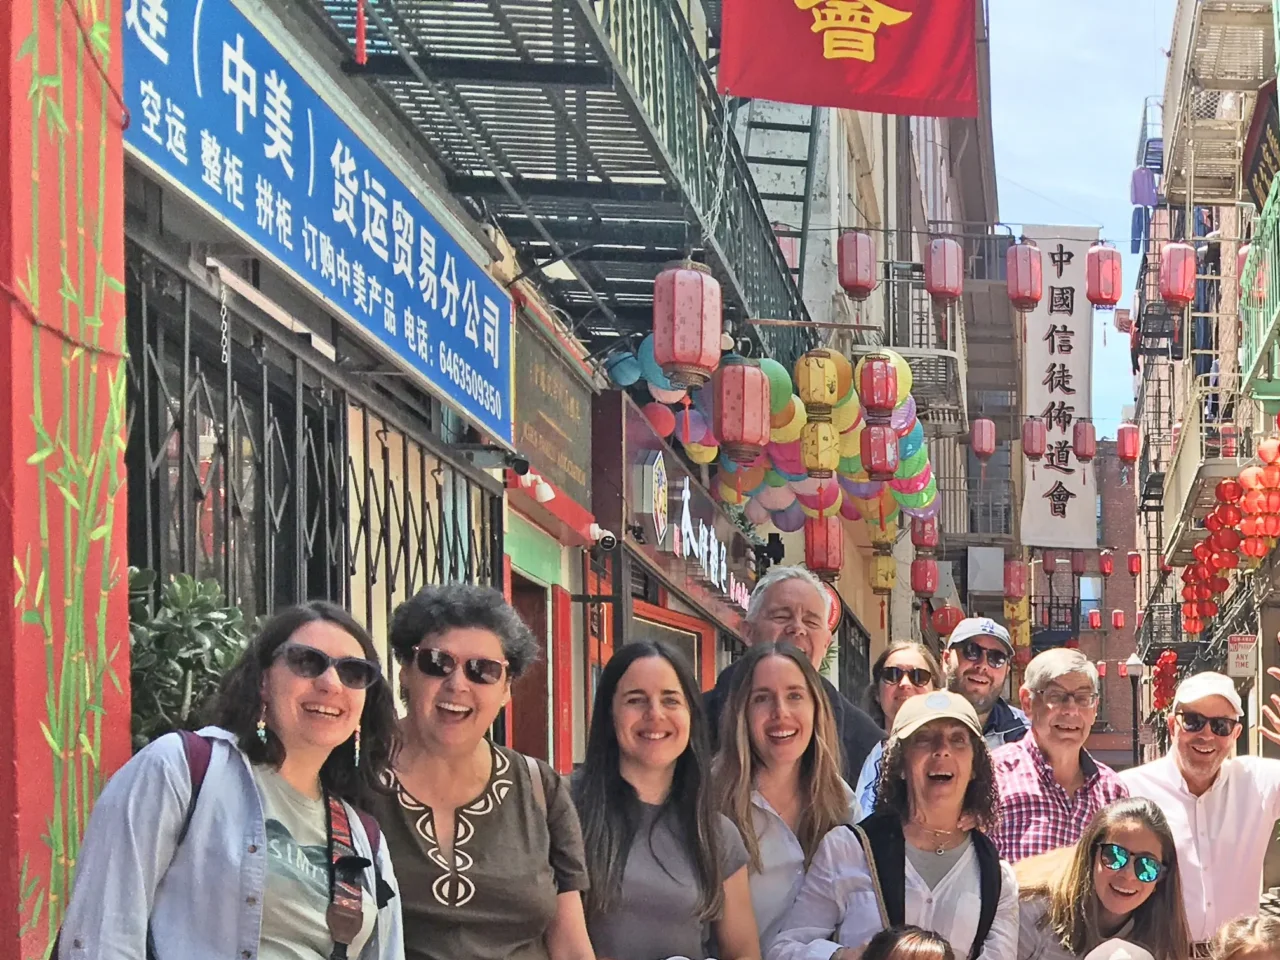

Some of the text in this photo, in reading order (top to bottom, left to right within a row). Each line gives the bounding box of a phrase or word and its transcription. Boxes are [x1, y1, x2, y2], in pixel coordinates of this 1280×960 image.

[140, 80, 189, 166] 空运
[200, 128, 245, 211] 整柜
[255, 173, 293, 251] 拼柜
[302, 216, 397, 336] 订购中美产品
[439, 341, 502, 420] 6463509350
[1042, 243, 1077, 519] 中國信徒佈道會
[1235, 661, 1250, 669] TIME
[1236, 653, 1249, 661] ANY
